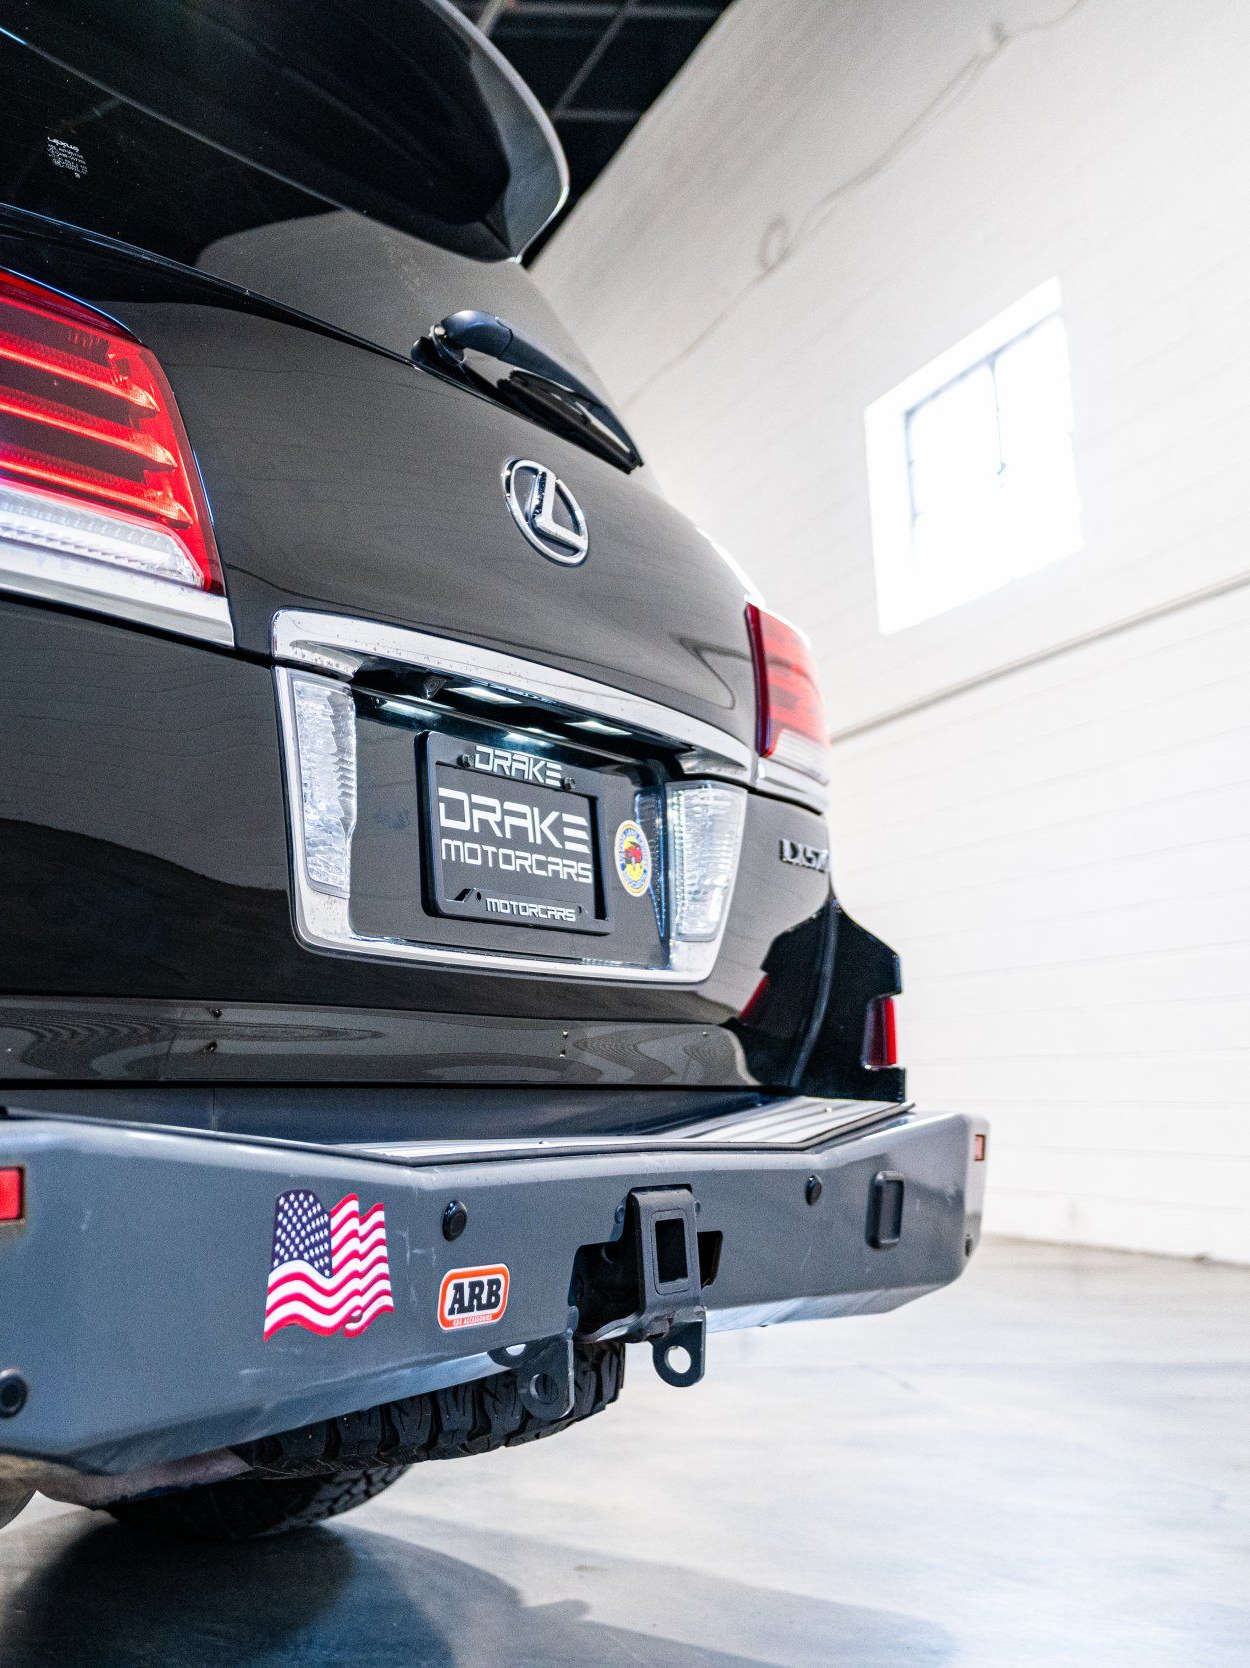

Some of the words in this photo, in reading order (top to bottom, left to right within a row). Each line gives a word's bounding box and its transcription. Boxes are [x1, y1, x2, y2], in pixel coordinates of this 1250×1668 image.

[475, 745, 563, 786] DRAKE
[437, 787, 591, 854] DRAKE
[441, 838, 593, 884] MOTORCARS
[485, 897, 576, 922] MOTORCARS
[447, 1277, 501, 1316] ARB
